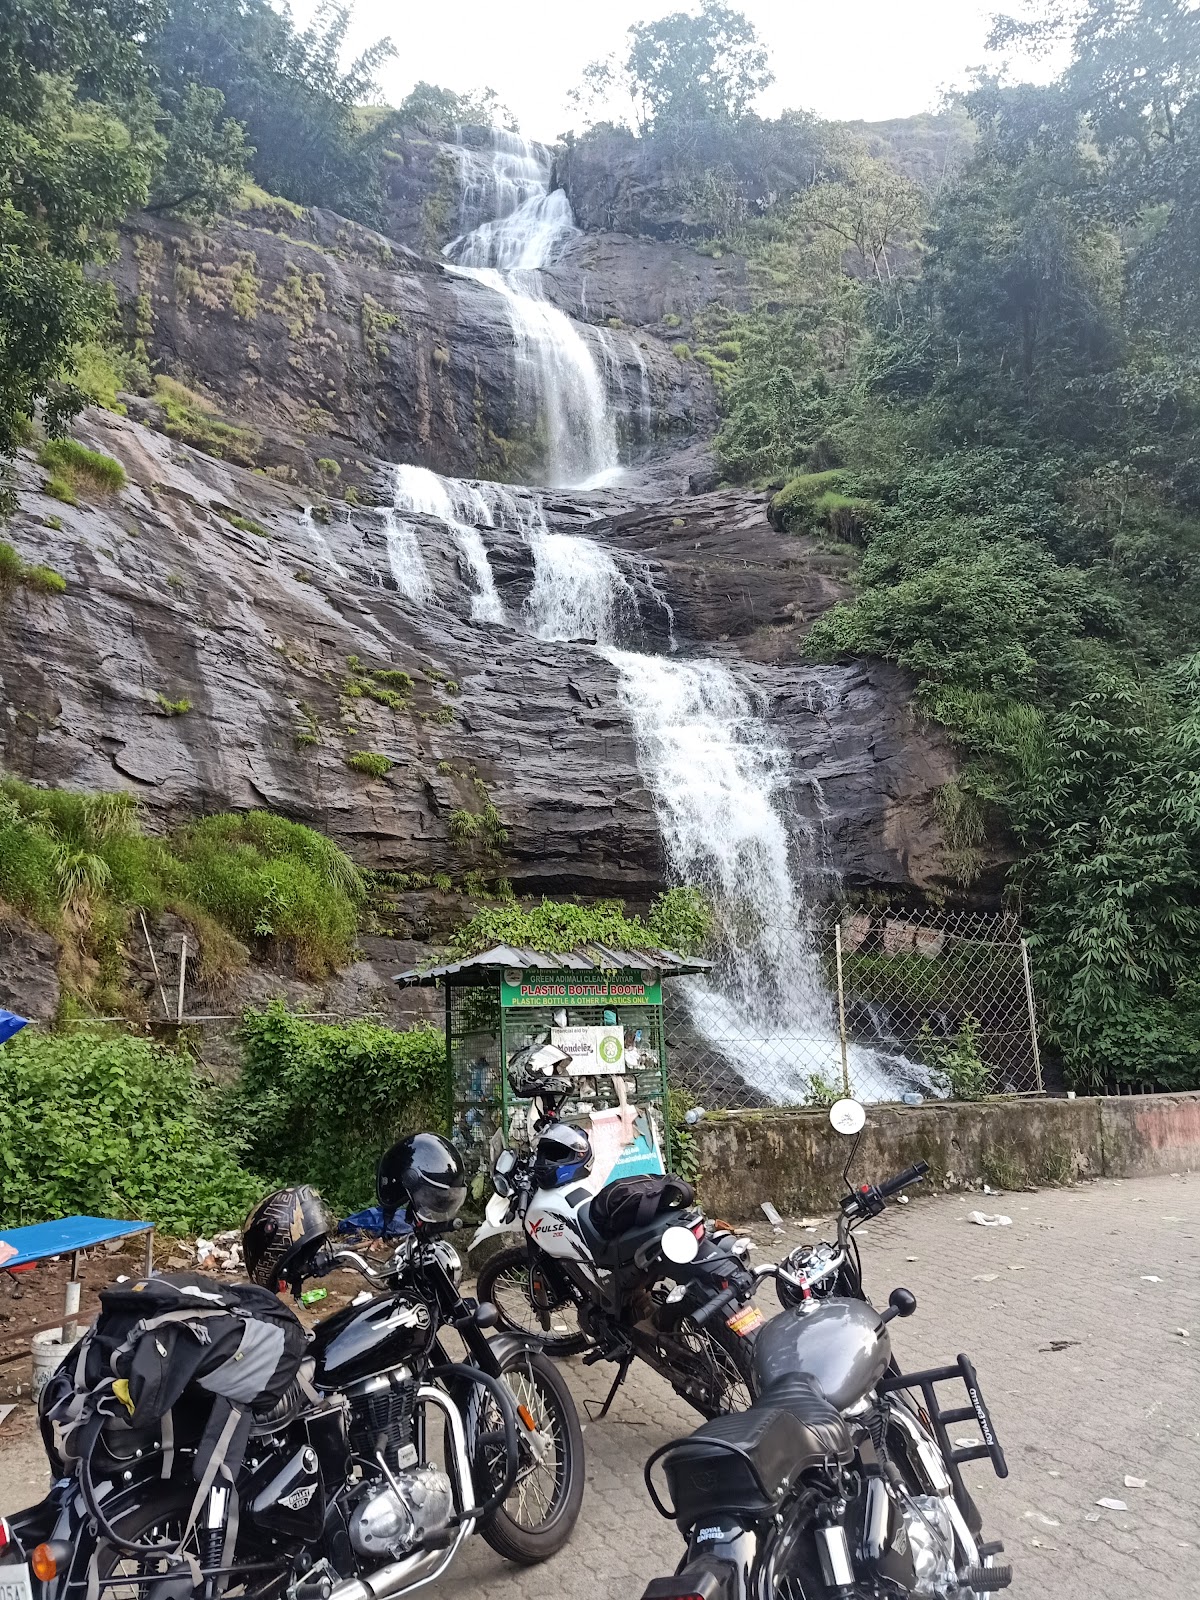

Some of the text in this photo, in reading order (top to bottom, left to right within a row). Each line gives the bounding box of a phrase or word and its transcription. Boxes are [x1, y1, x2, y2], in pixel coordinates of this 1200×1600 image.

[530, 975, 554, 983] GREEN
[555, 975, 583, 983] ADIMALI
[520, 984, 645, 996] PLASTIC BOTTLE BOOTH
[512, 997, 541, 1005] PLASTIC
[542, 997, 568, 1005] BOTTLE
[577, 997, 599, 1005] OTHER
[600, 996, 631, 1005] PLASTICS
[632, 996, 649, 1004] ONLY
[969, 1387, 994, 1446] ROYAL ENFIELD
[699, 1526, 721, 1536] ROYAL
[696, 1532, 725, 1544] ENFIELD
